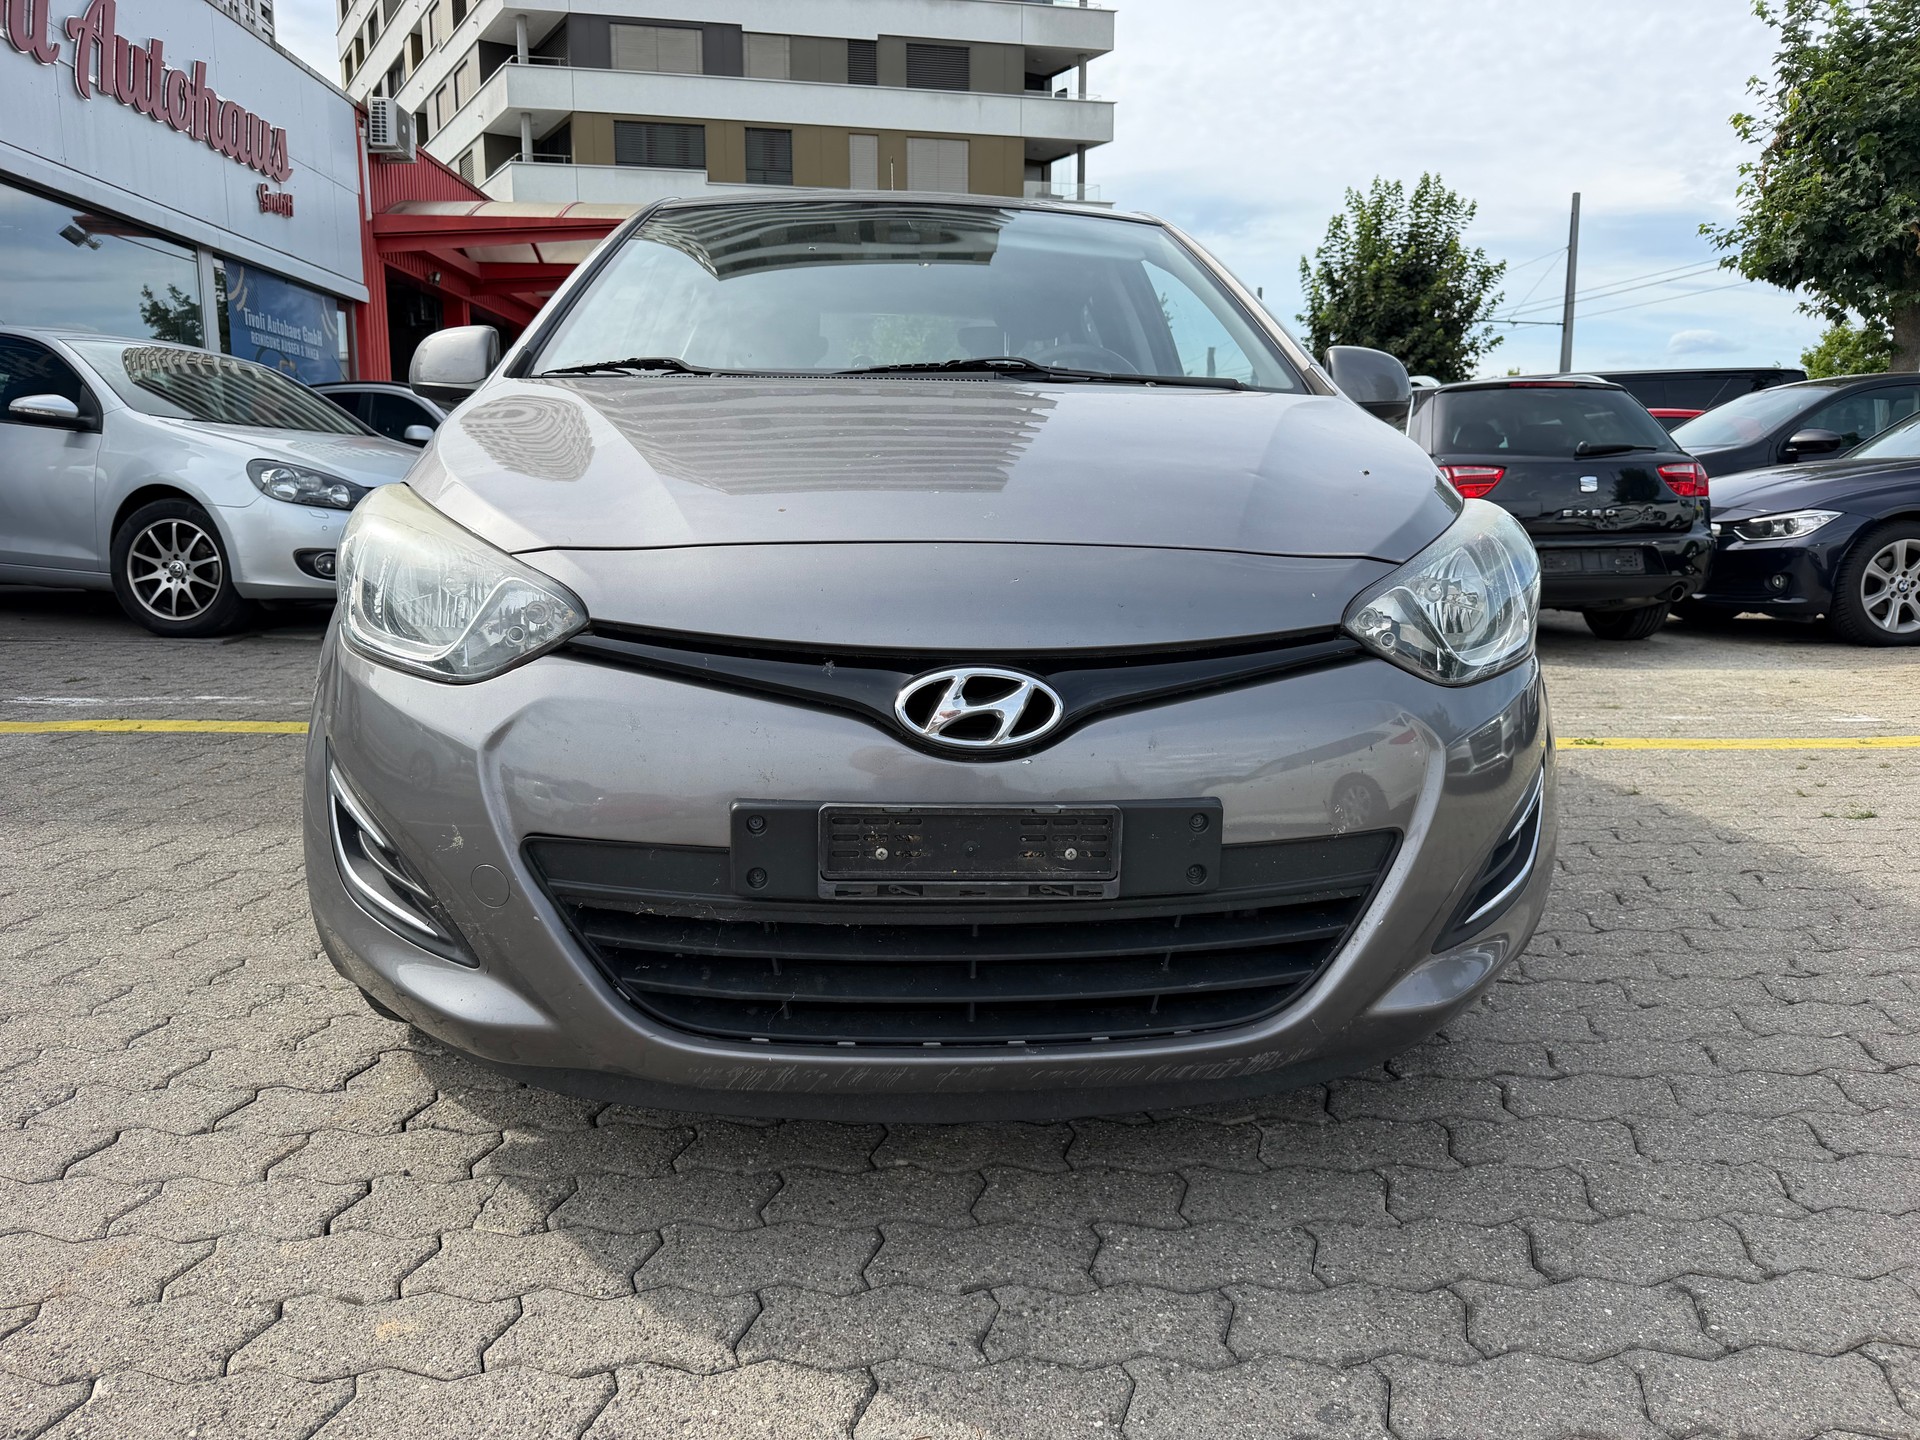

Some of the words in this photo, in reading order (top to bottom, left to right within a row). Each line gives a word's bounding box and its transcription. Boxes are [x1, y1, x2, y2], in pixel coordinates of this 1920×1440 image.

[65, 0, 293, 183] Autohaus
[257, 182, 294, 218] GmbH
[243, 307, 266, 331] Tivoli
[267, 314, 301, 341] Autohaus
[302, 325, 323, 347] GmbH
[250, 330, 281, 351] REINIGUNG
[280, 339, 301, 356] AUSSEN
[1562, 509, 1616, 517] EXEO
